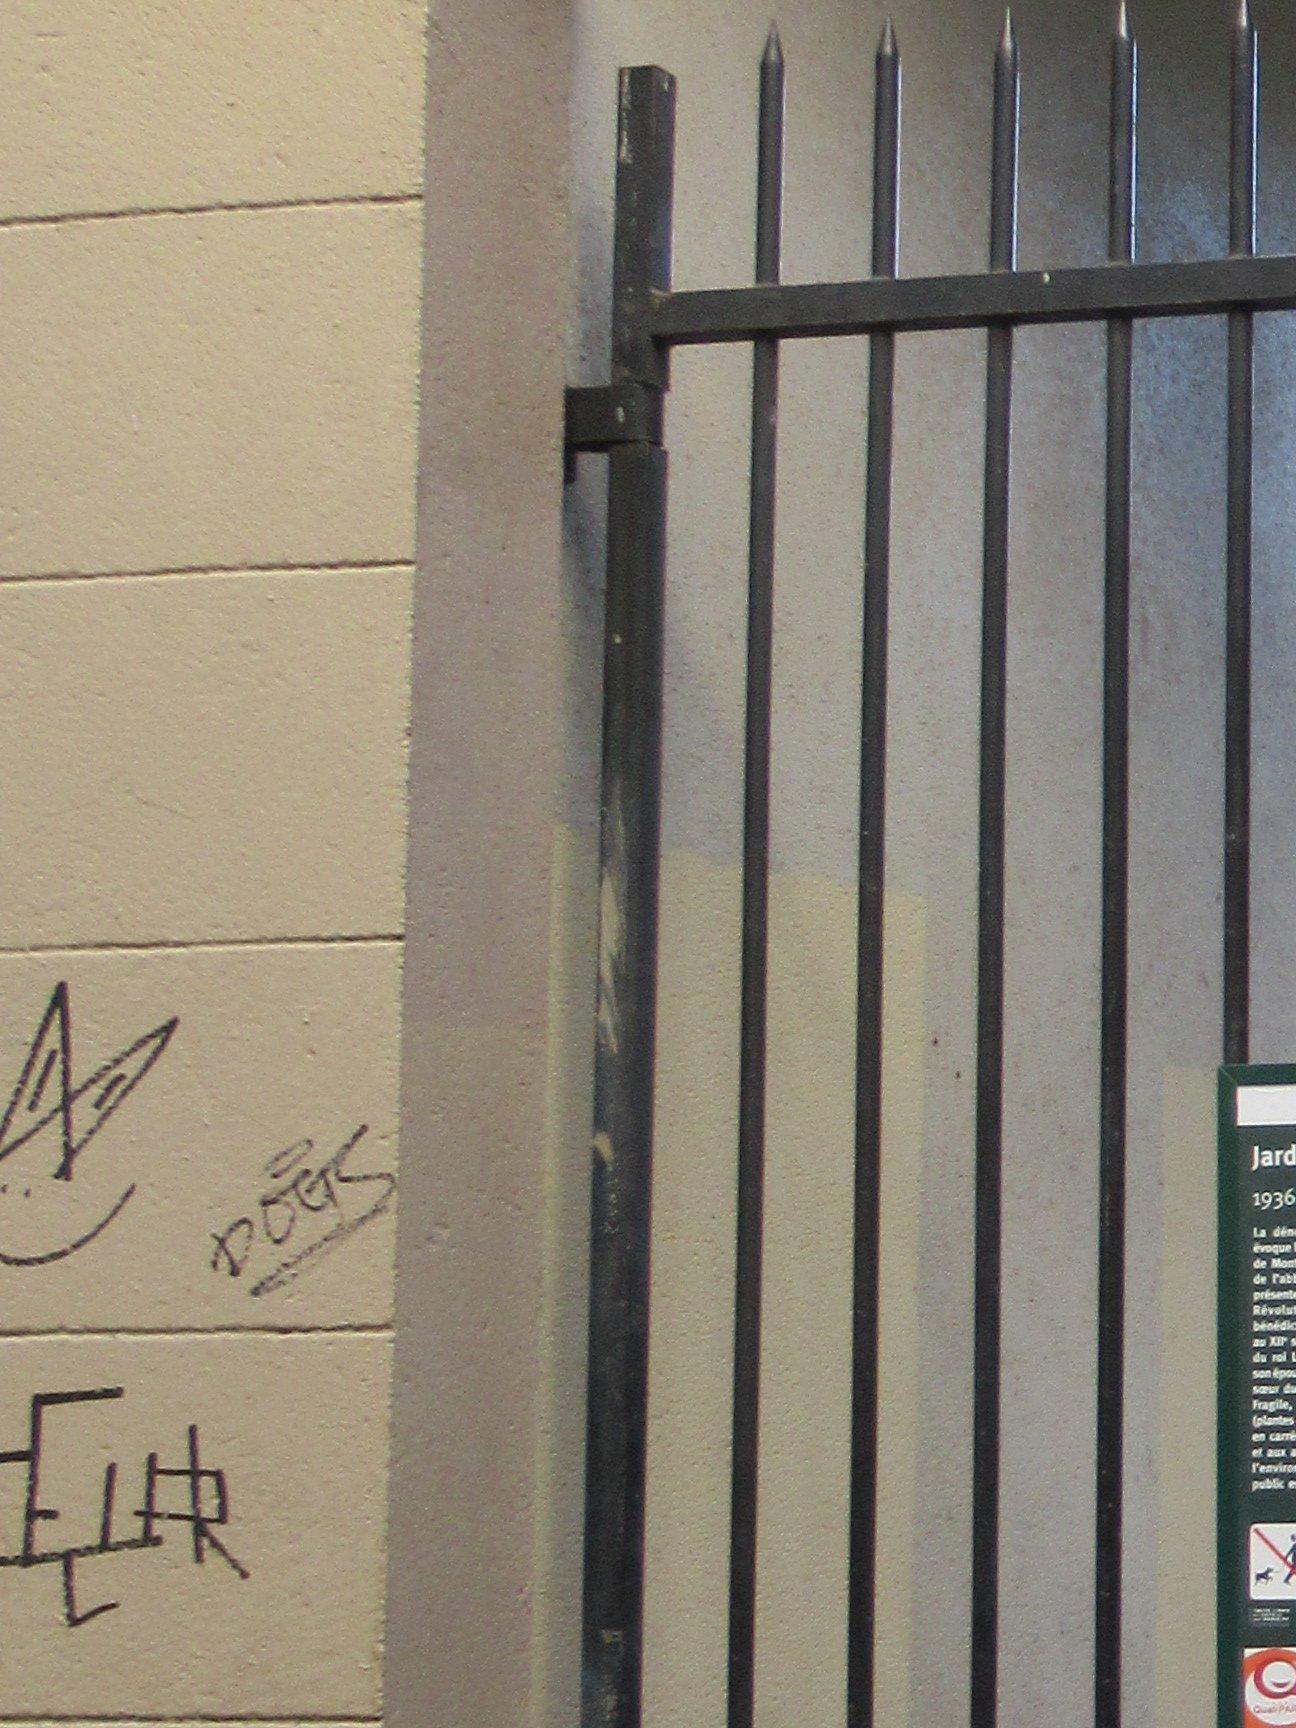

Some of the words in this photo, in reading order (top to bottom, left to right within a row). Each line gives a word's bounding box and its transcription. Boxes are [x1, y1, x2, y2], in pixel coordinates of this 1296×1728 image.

[1252, 1188, 1296, 1210] 1936
[1253, 1228, 1266, 1238] La
[1253, 1259, 1267, 1269] de
[1253, 1274, 1267, 1285] de
[1253, 1352, 1267, 1363] du
[1252, 1432, 1266, 1442] en
